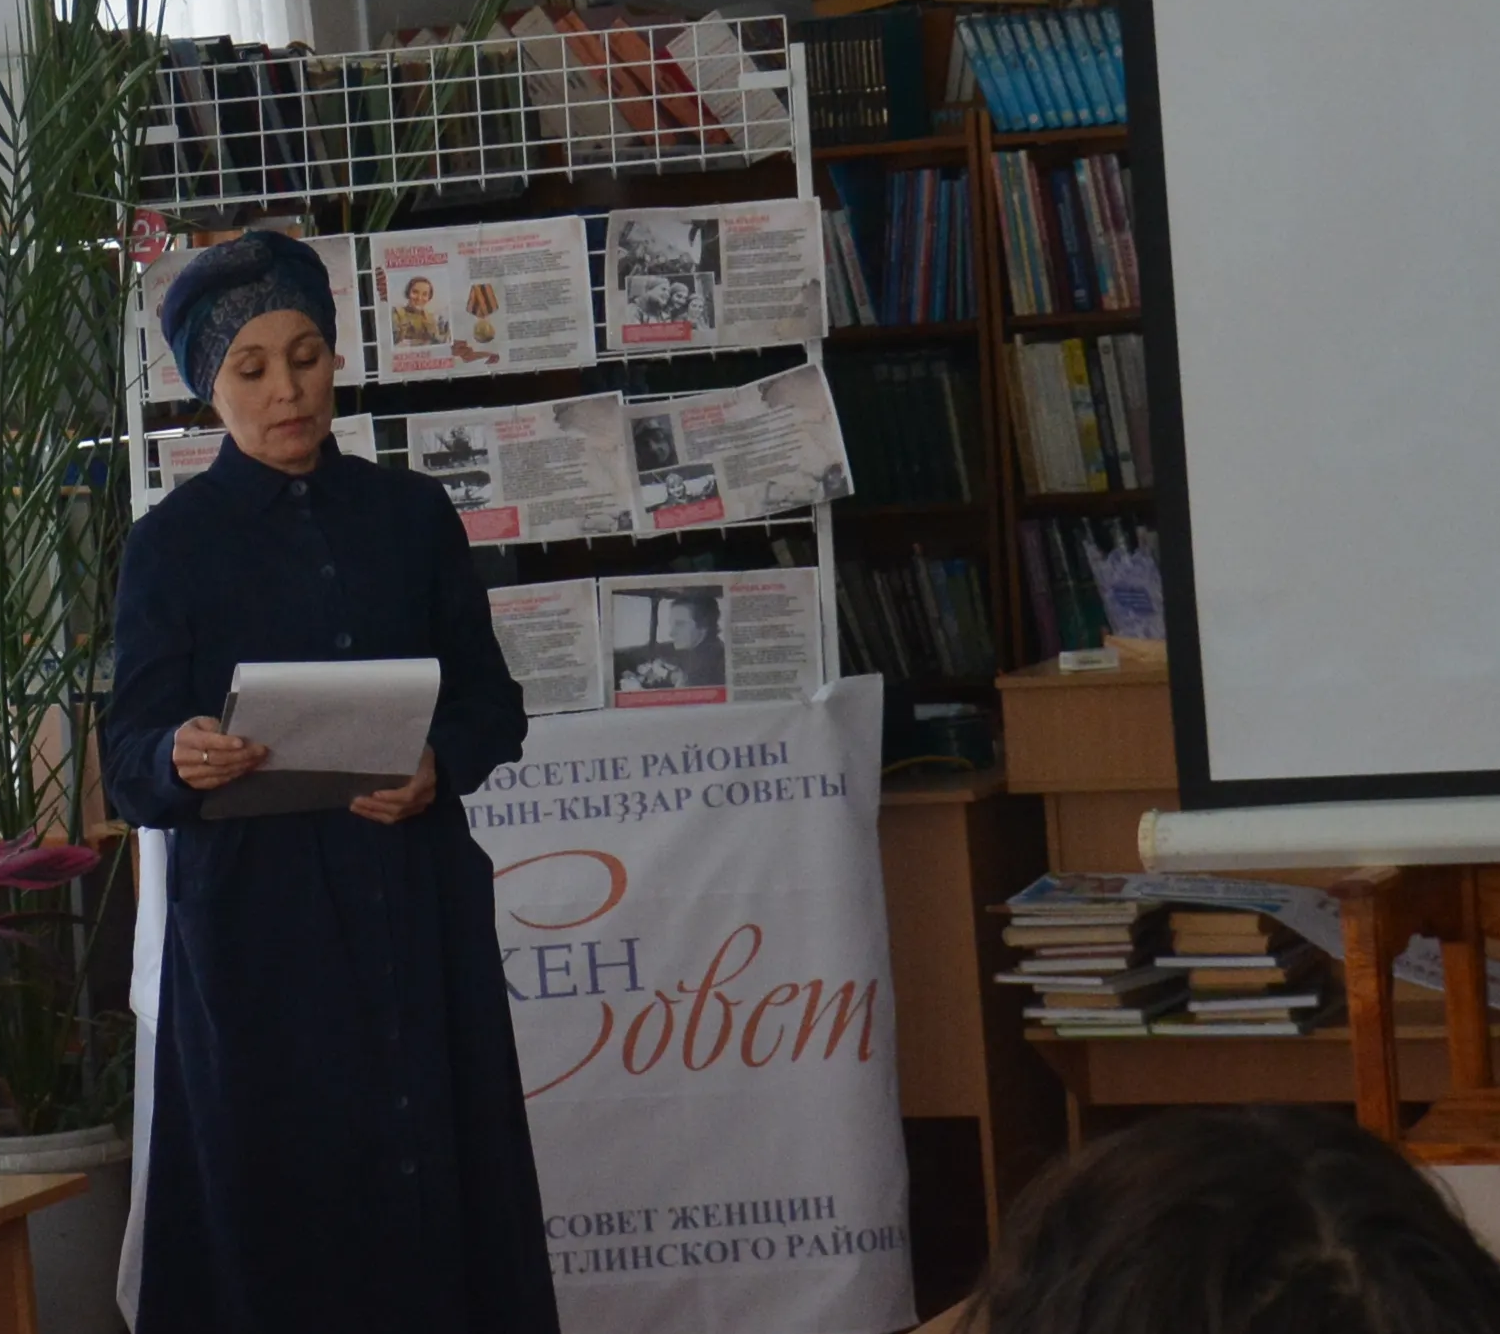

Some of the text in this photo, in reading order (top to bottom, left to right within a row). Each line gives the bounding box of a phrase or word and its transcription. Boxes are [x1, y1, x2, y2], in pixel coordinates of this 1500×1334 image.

[129, 219, 167, 254] 2+
[641, 740, 789, 778] РАЙОНЫ
[701, 772, 848, 809] СОВЕТЫ
[544, 1195, 836, 1240] СОВЕТ ЖЕНЩИН
